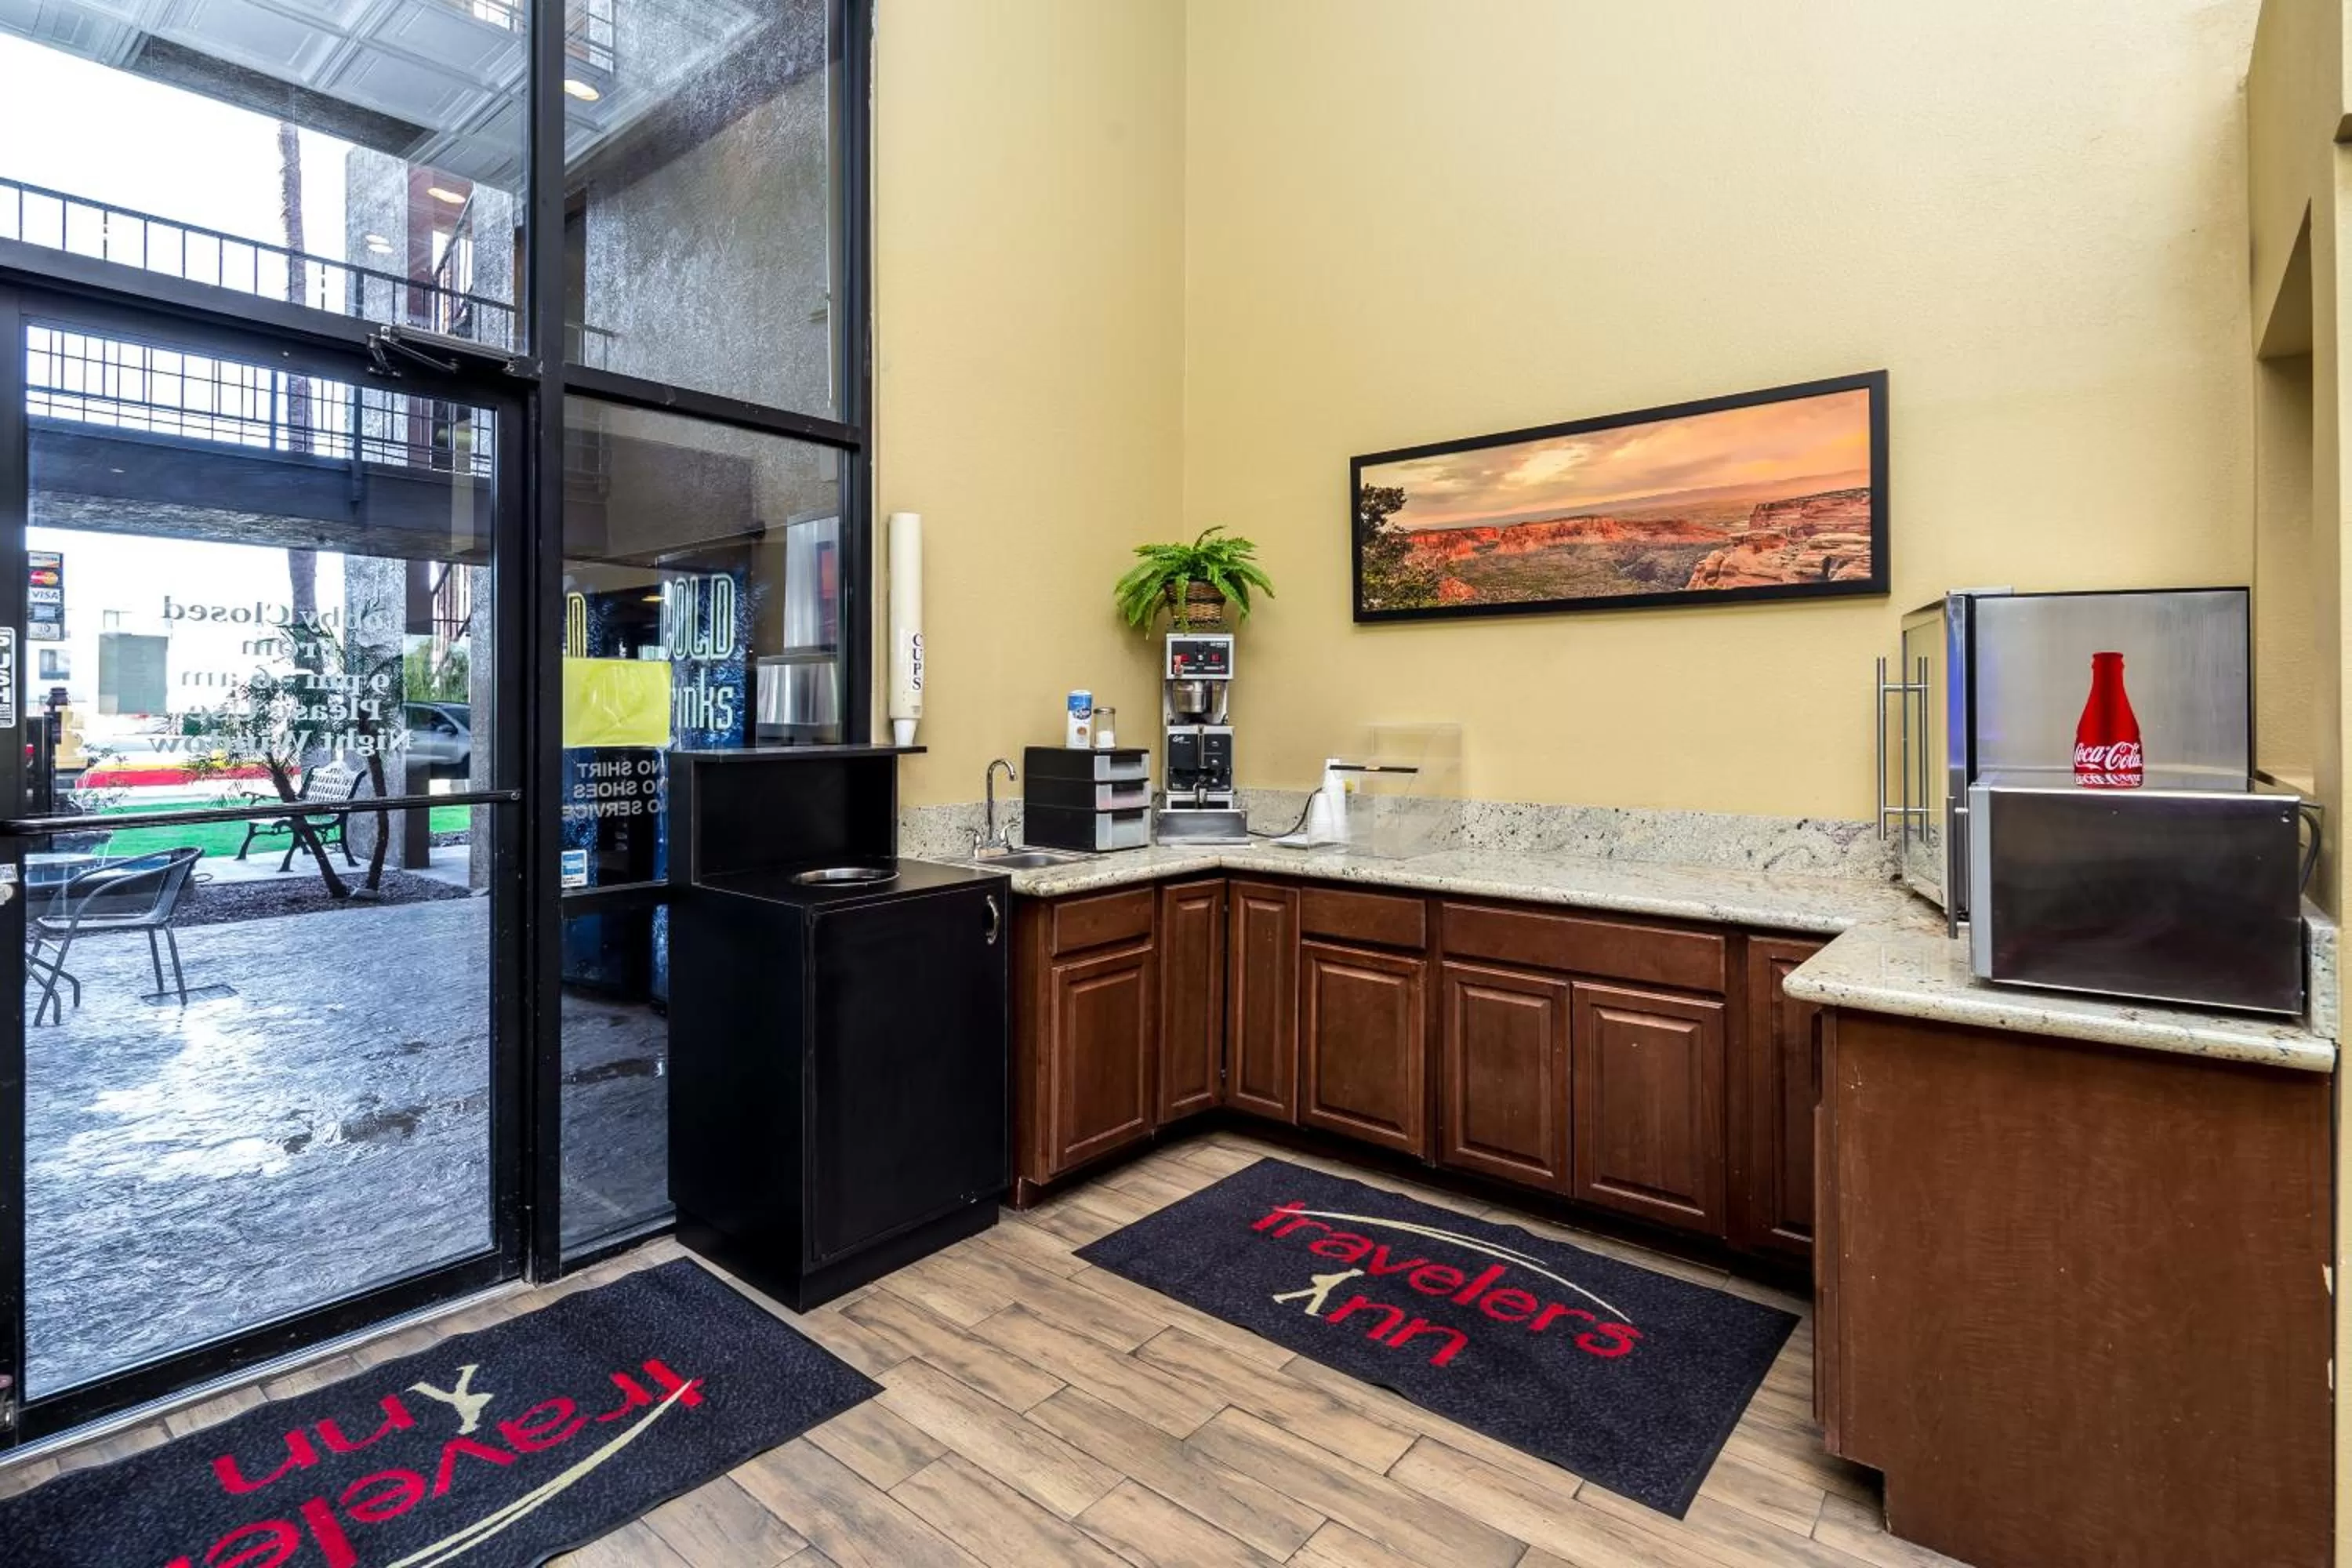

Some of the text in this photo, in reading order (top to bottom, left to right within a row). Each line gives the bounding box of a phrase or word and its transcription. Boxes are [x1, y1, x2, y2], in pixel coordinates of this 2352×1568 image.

[31, 590, 59, 600] VISA
[659, 574, 735, 660] COLD
[912, 633, 923, 691] CUPS
[2075, 742, 2142, 770] Coca-Cola
[1250, 1200, 1644, 1358] travelers
[165, 1358, 704, 1568] travele
